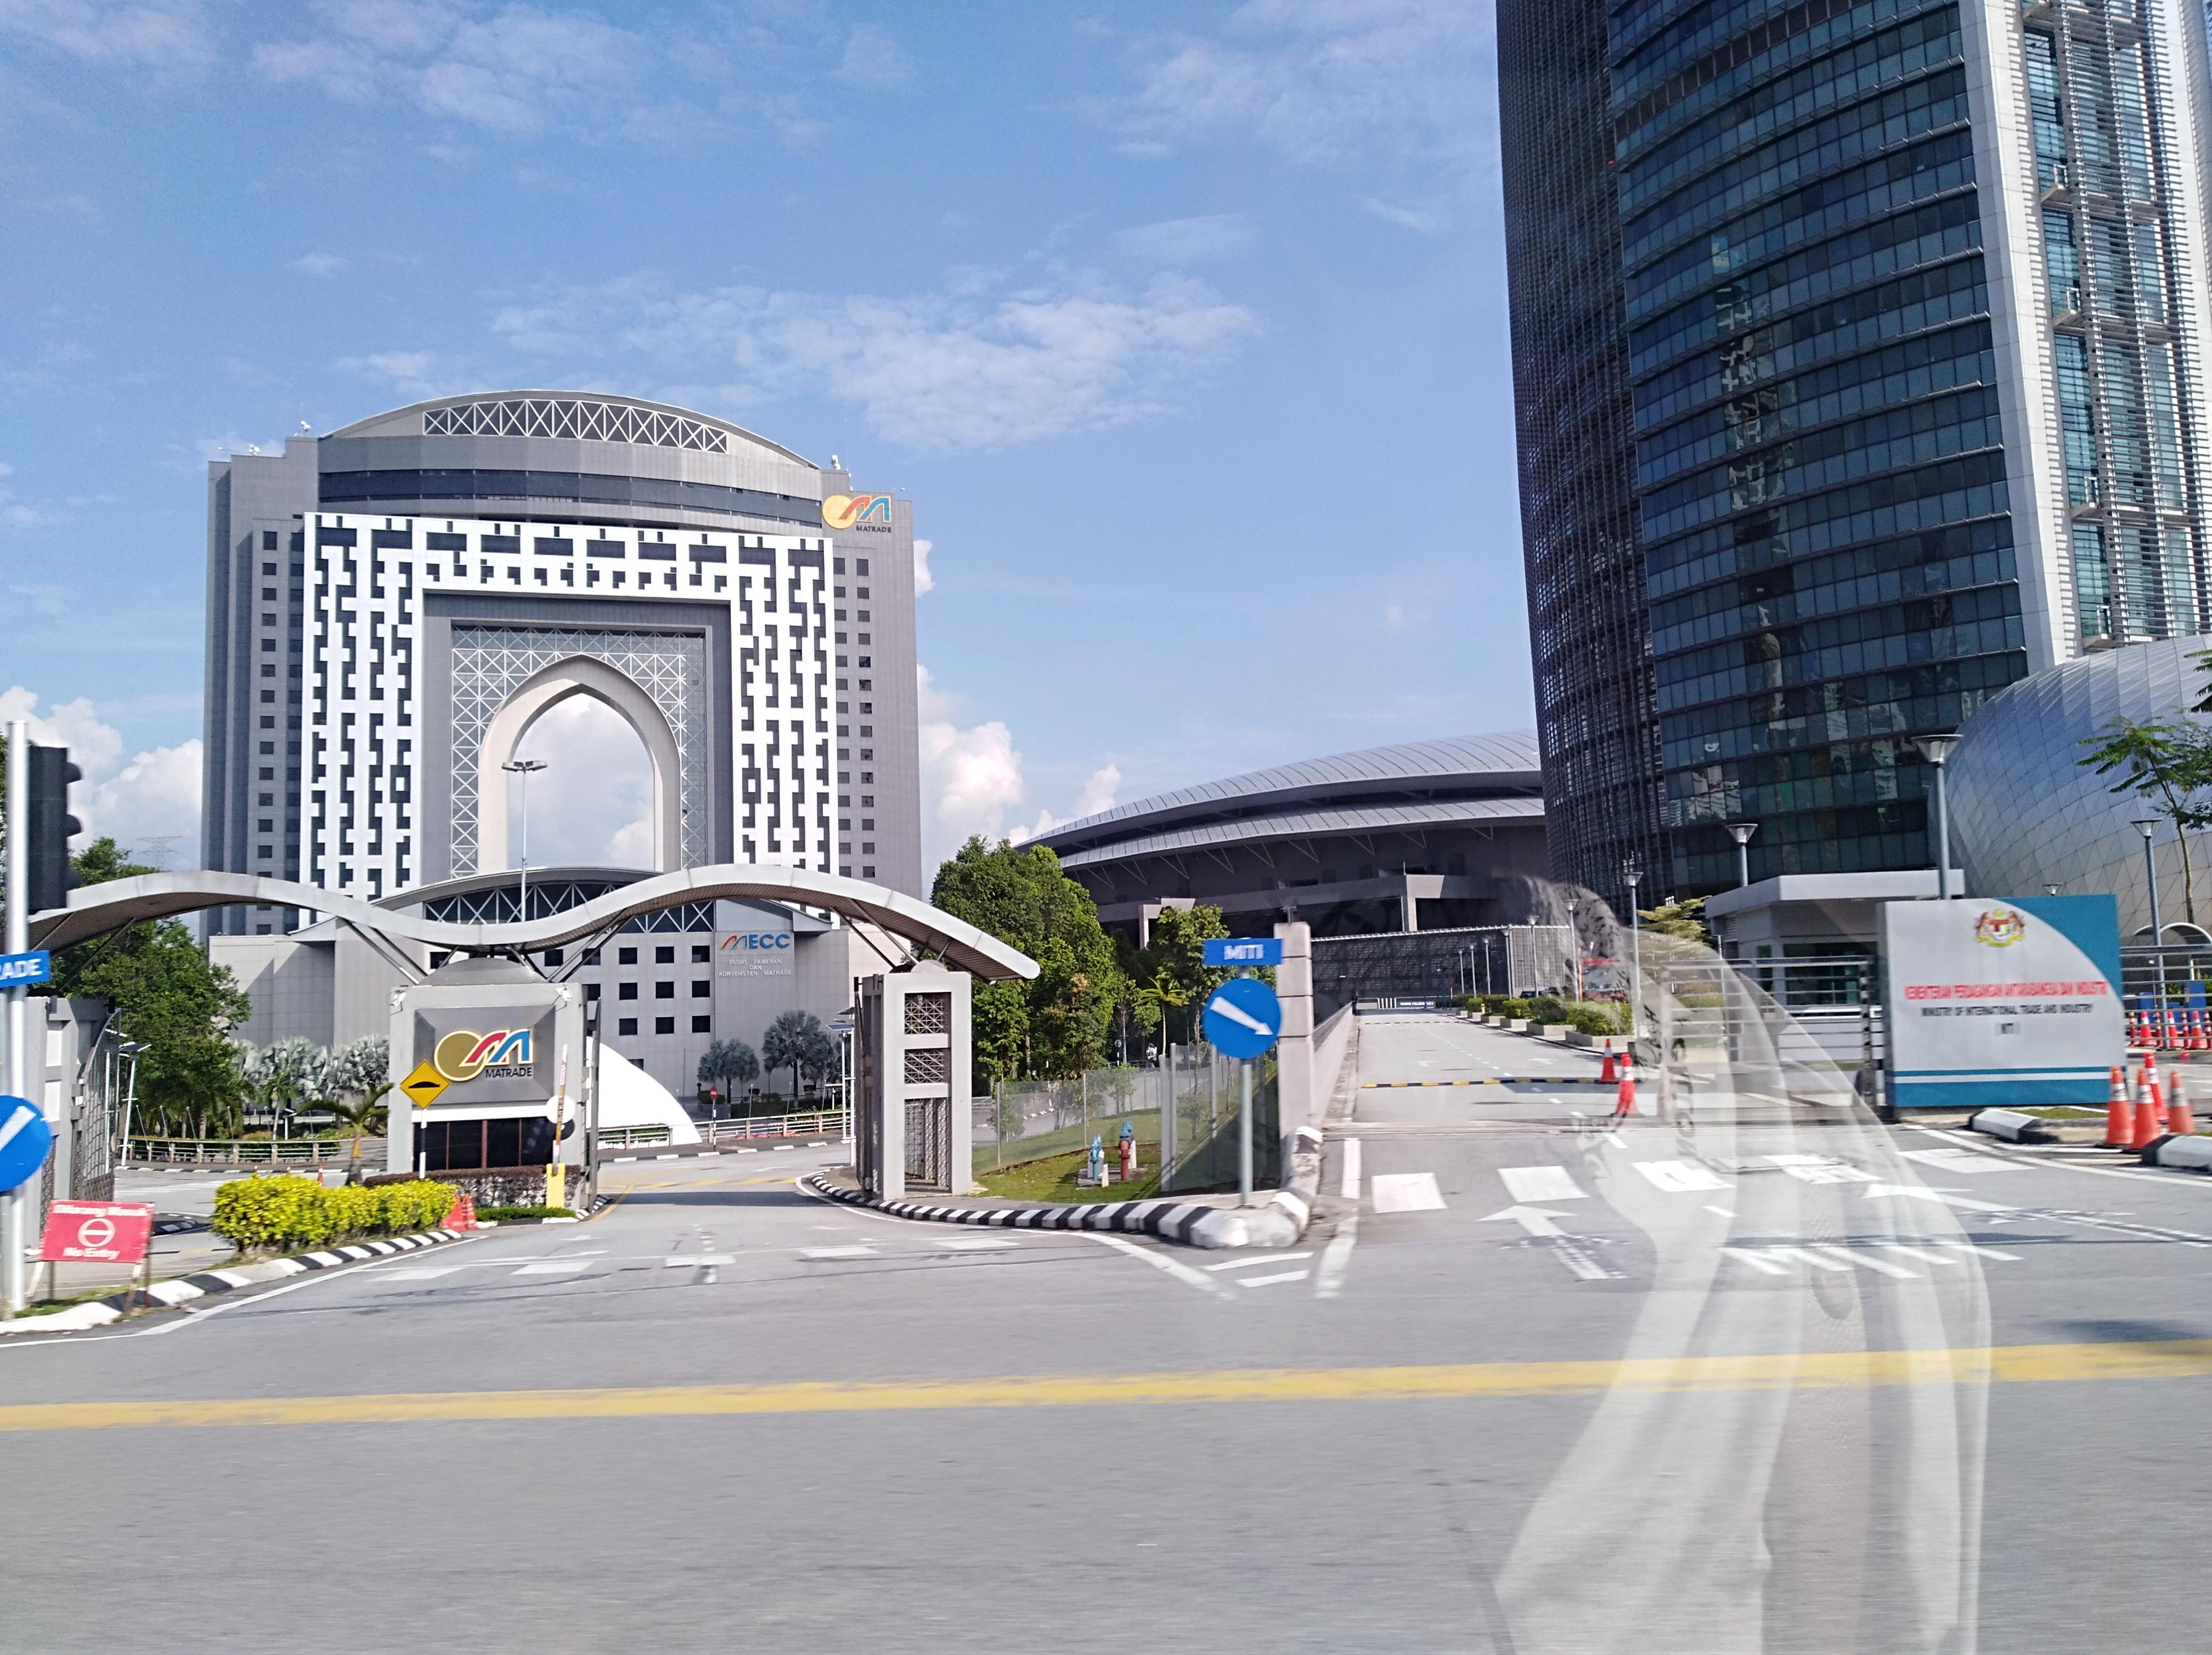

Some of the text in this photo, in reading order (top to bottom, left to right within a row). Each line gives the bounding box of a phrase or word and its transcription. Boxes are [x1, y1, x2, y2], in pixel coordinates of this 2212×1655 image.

[720, 933, 791, 949] MECC
[1224, 944, 1263, 960] MITI
[486, 1067, 533, 1078] MATRADE
[63, 1247, 121, 1260] No Entry
